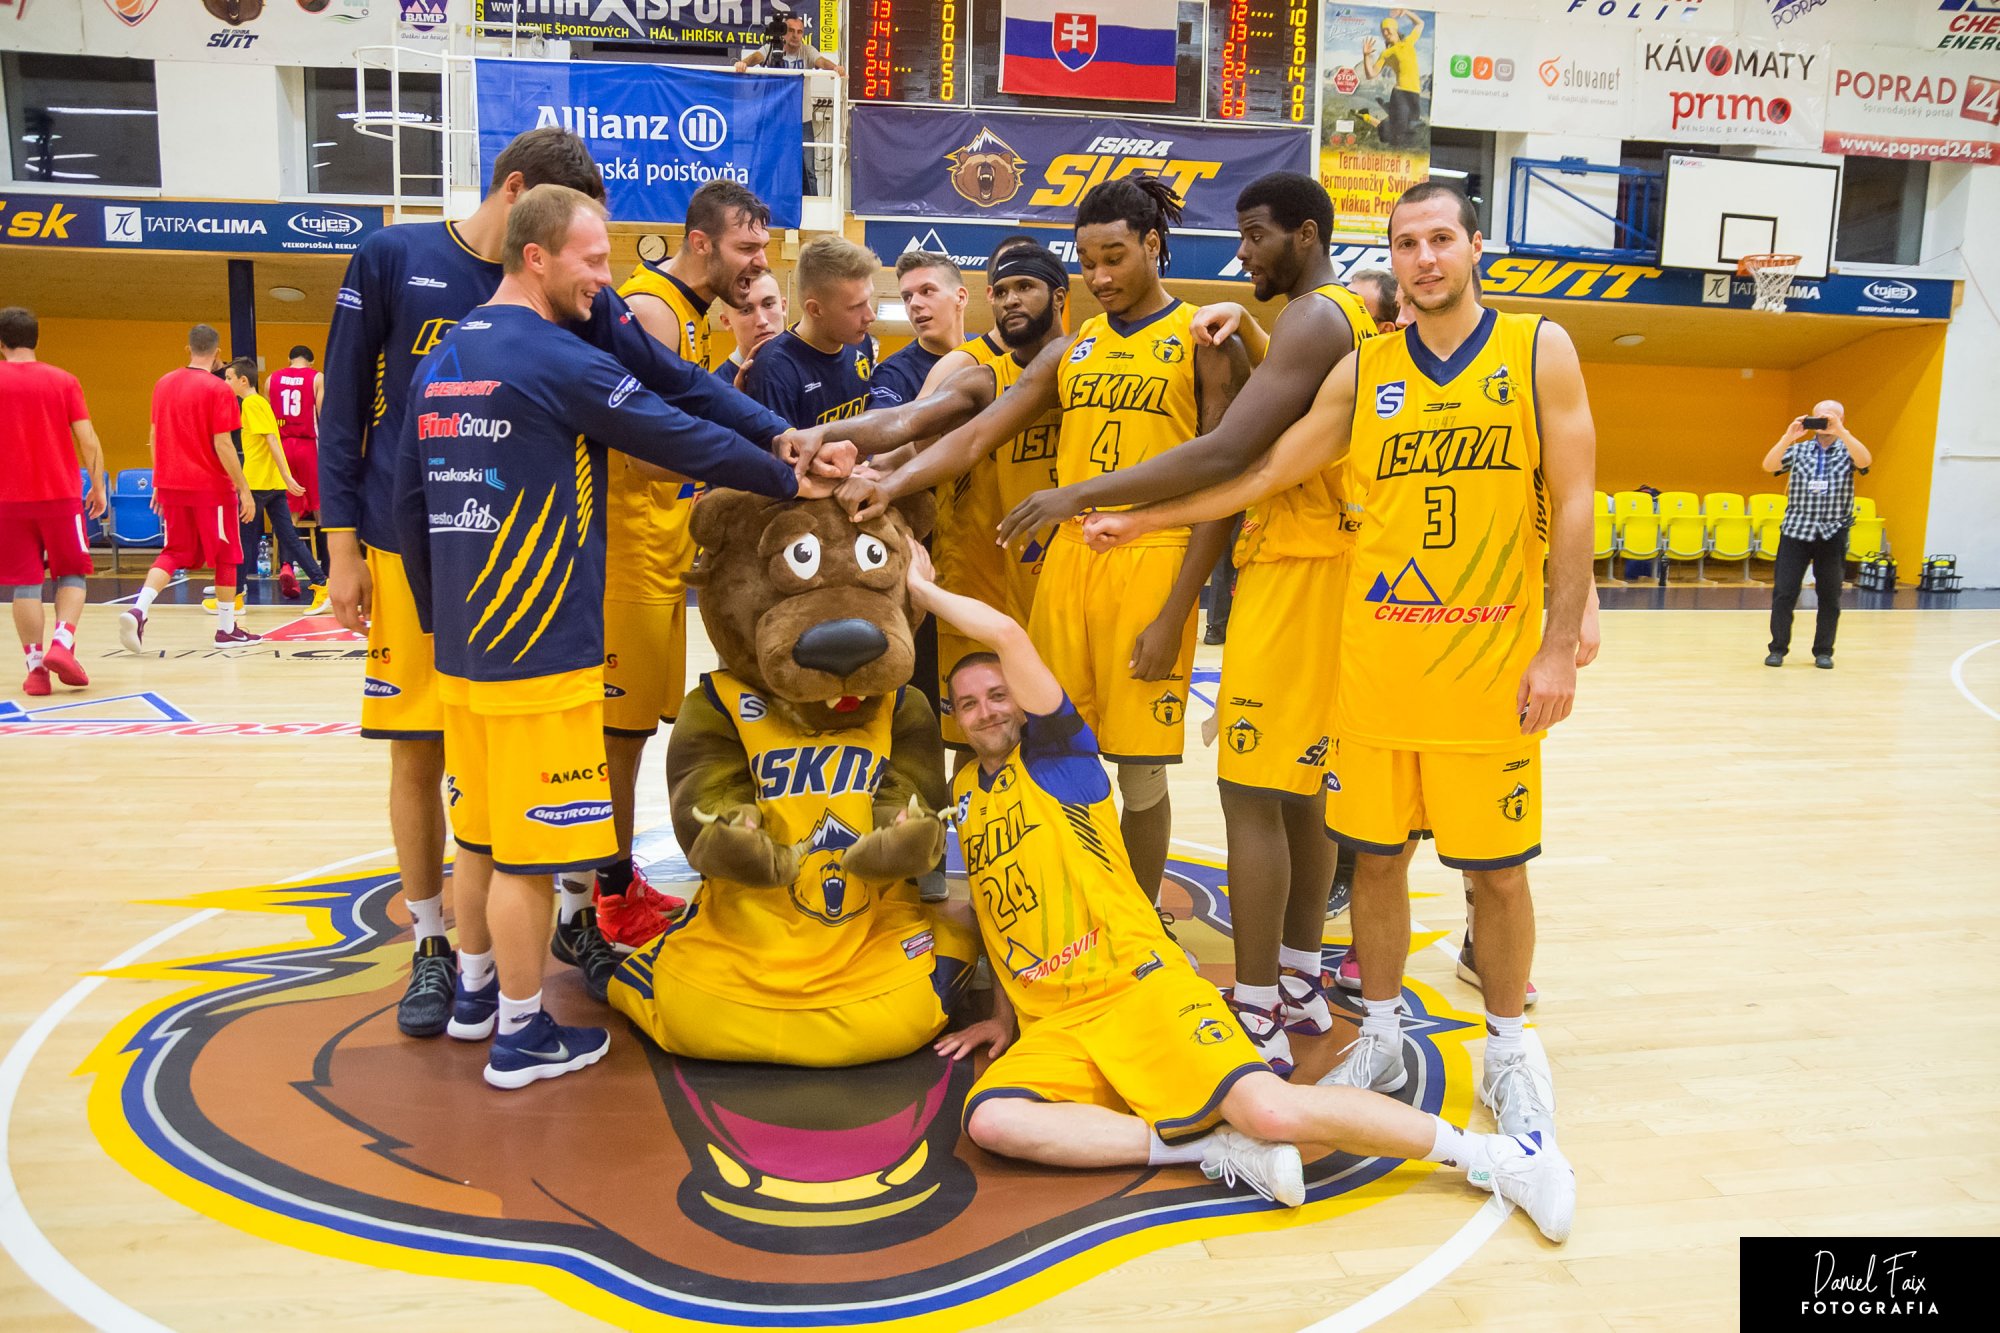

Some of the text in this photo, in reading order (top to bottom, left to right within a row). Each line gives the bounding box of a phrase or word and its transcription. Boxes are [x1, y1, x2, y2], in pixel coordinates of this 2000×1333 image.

[405, 13, 446, 23] BAMP
[942, 4, 955, 22] 0
[1290, 8, 1307, 27] 10
[207, 33, 259, 48] SVIT
[555, 22, 630, 38] ŠPORTOVÝCH
[649, 26, 679, 42] HÁL,
[681, 27, 723, 43] IHRÍSK
[726, 31, 735, 43] A
[942, 23, 955, 42] 0
[1293, 28, 1306, 46] 6
[942, 42, 955, 61] 0
[1293, 46, 1306, 65] 0
[1645, 38, 1815, 80] KÁVOMATY
[942, 62, 954, 81] 5
[1288, 66, 1306, 83] 14
[1564, 60, 1621, 91] slovanet
[941, 82, 954, 101] 0
[1292, 84, 1305, 103] 0
[1835, 69, 1957, 104] POPRAD
[1291, 103, 1305, 122] 0
[1669, 90, 1793, 130] primo
[535, 105, 669, 141] Allianz
[1679, 125, 1721, 134] VENDING
[1086, 136, 1173, 156] ISKRA
[1839, 136, 1993, 159] www.poprad24.sk
[646, 158, 749, 186] poisťovňa
[1405, 159, 1411, 173] a
[1341, 194, 1370, 213] vlákna
[144, 216, 268, 236] TATRACLIMA
[1481, 257, 1662, 299] SVIT
[280, 388, 302, 417] 13
[1063, 373, 1173, 418] ISKRA
[1090, 421, 1121, 473] 4
[1376, 425, 1523, 481] ISKRA
[1423, 484, 1456, 550] 3
[1374, 604, 1517, 625] CHEMOSVIT
[980, 860, 1039, 934] 24
